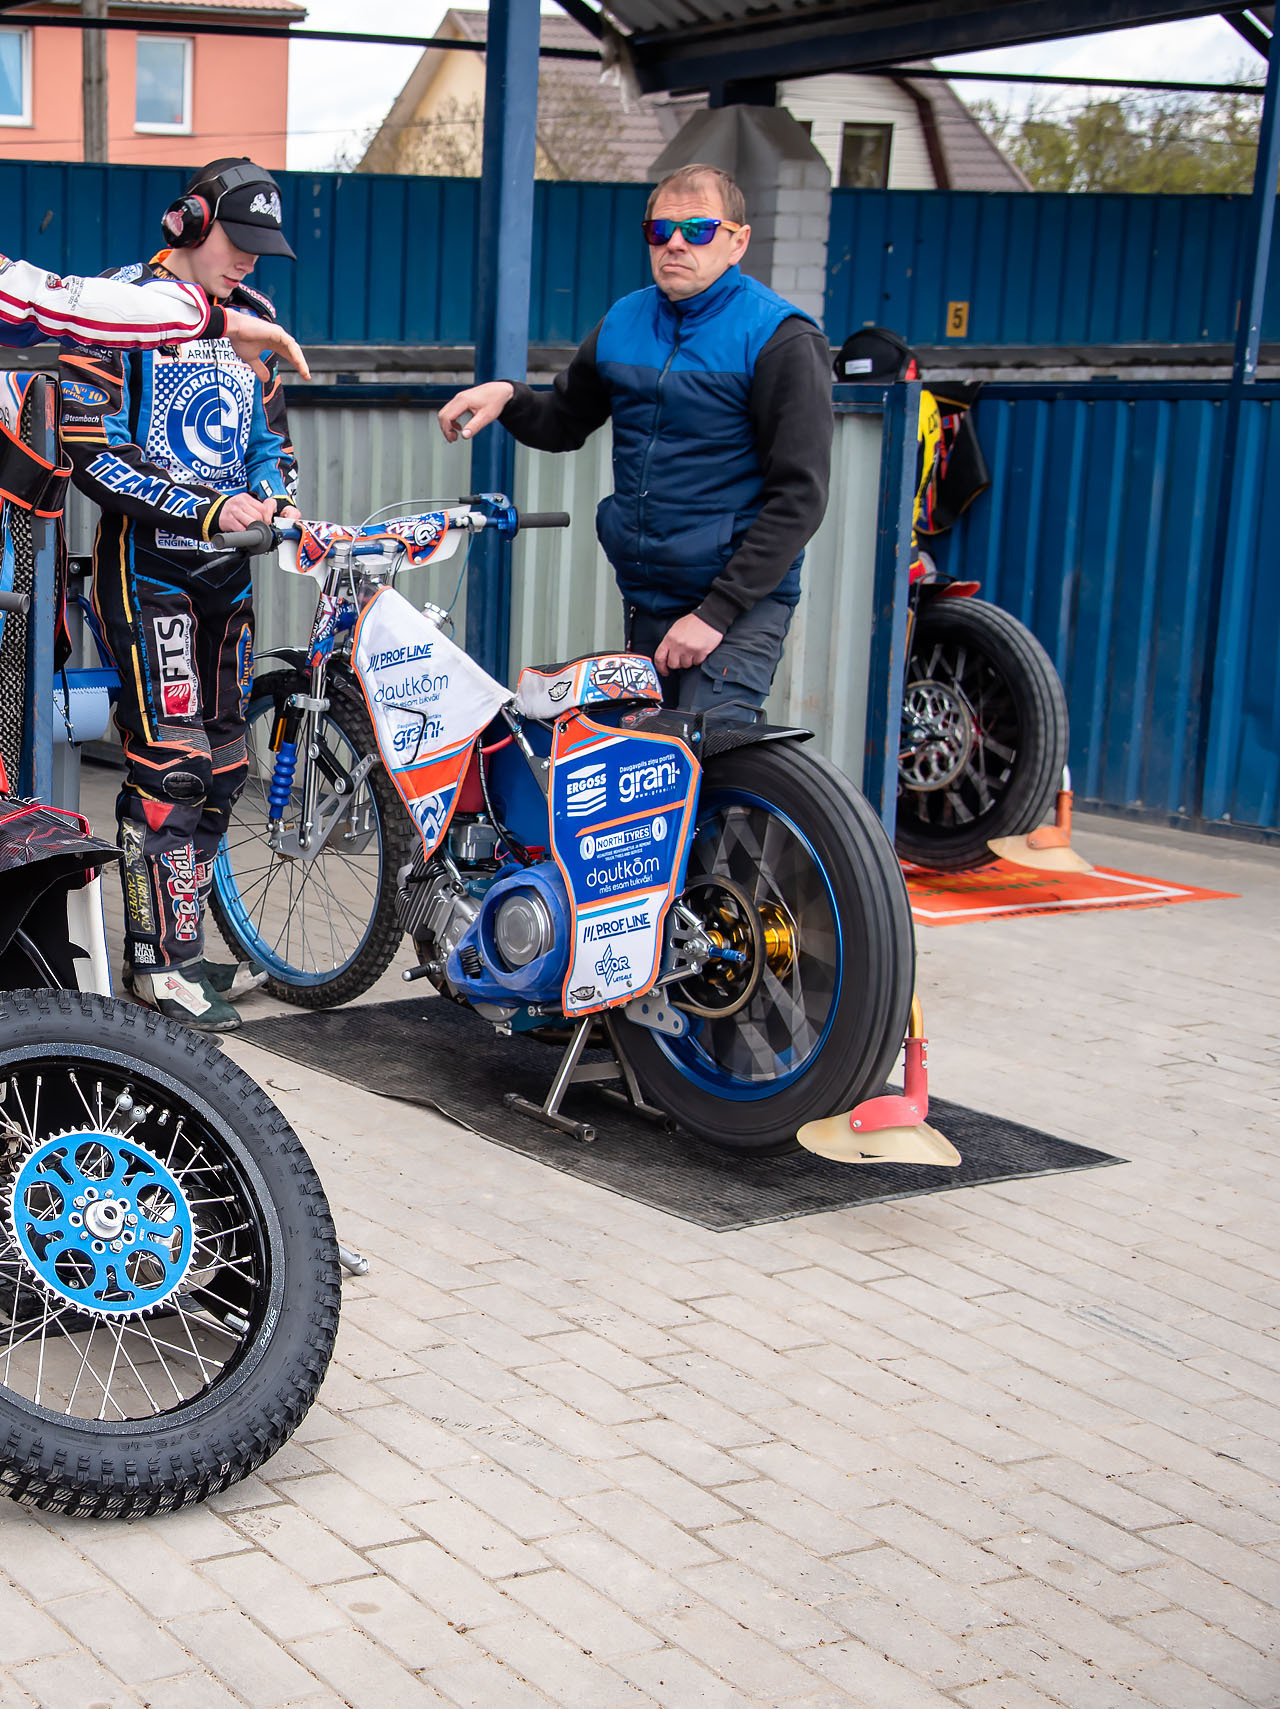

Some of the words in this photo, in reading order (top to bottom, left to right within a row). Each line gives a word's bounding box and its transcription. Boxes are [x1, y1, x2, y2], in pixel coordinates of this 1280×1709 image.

[953, 307, 964, 329] 5
[198, 338, 233, 349] THOMA
[62, 387, 86, 403] tering
[88, 390, 104, 403] 10
[64, 413, 100, 424] @teambach
[191, 459, 242, 478] COMETS
[85, 451, 171, 507] TEAM
[160, 486, 211, 519] TK
[157, 618, 189, 683] FTS
[566, 773, 607, 795] ERGOSS
[596, 834, 623, 849] NORTH
[624, 827, 650, 842] TYRES
[126, 871, 141, 922] CARPETS
[135, 873, 152, 932] KIRKLAND
[595, 955, 631, 976] EVOR
